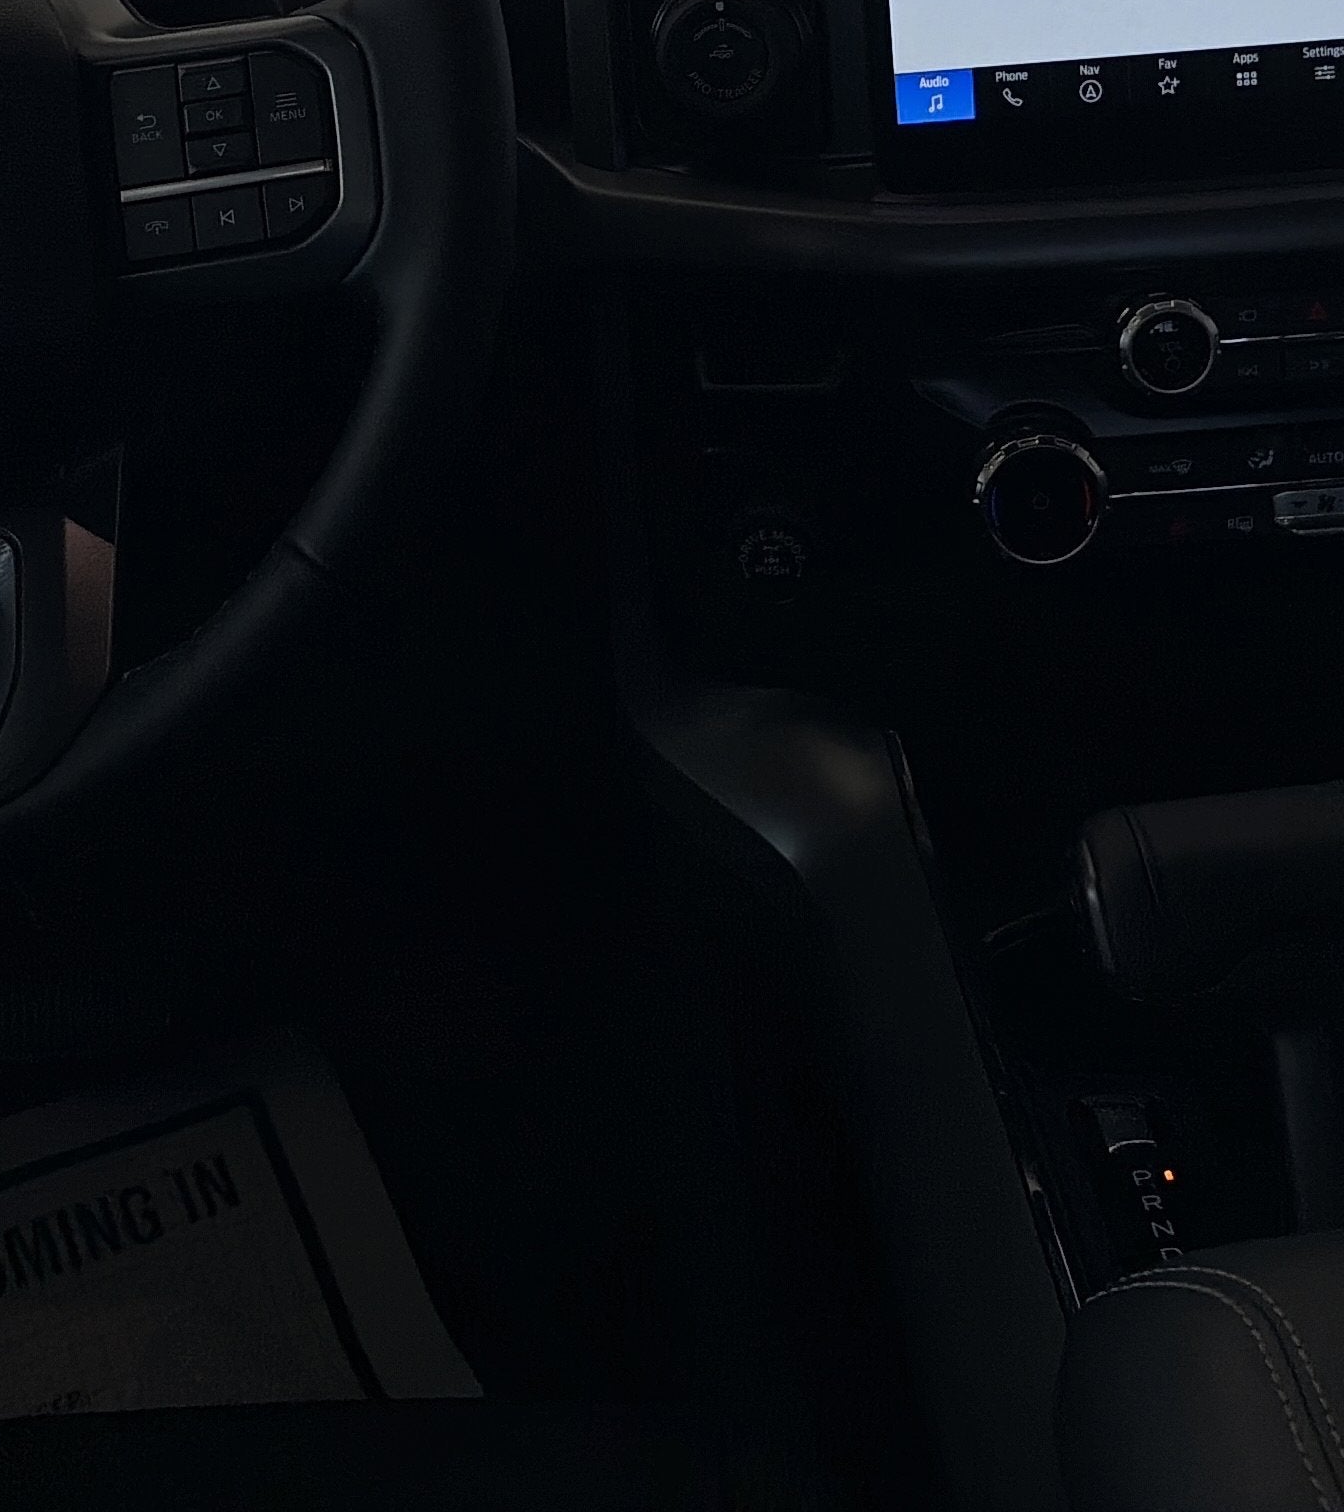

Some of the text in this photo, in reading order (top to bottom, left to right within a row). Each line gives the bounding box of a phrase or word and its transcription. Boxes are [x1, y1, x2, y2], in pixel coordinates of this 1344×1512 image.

[1158, 58, 1177, 69] Fav
[1233, 51, 1259, 65] Apps
[995, 70, 1028, 82] Phone
[1079, 64, 1100, 76] Nav
[686, 68, 764, 99] PRO TRAILER
[919, 75, 949, 88] Audio
[206, 110, 223, 121] OK
[270, 108, 306, 122] MENU
[132, 130, 164, 144] BACK
[1308, 451, 1344, 464] AUTO
[1132, 1169, 1152, 1186] P
[163, 1153, 241, 1224] IN
[1141, 1195, 1164, 1211] R
[1151, 1220, 1175, 1238] N
